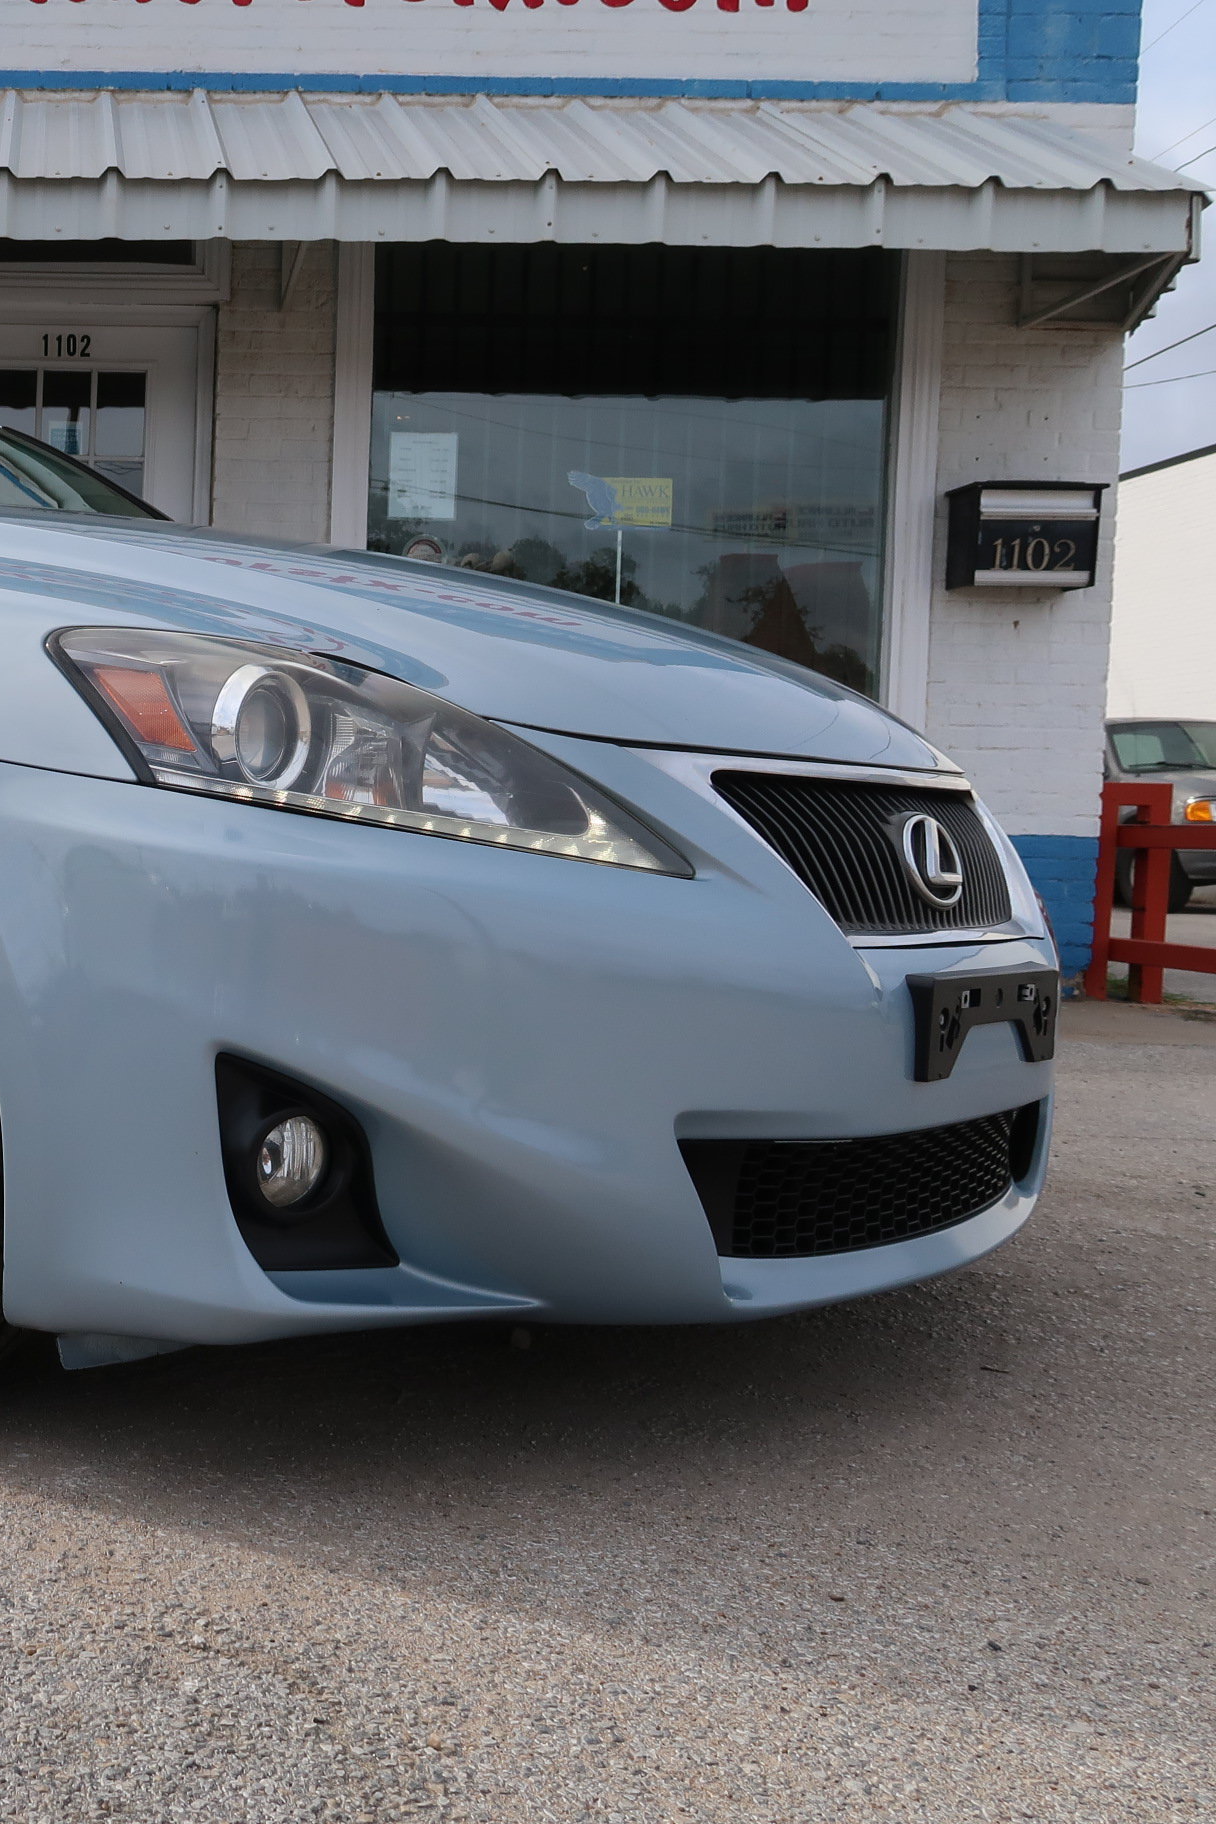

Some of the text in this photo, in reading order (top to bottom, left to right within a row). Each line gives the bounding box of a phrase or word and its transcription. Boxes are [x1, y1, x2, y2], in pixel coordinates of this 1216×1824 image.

[42, 334, 91, 357] 1102
[622, 485, 669, 497] HAWK
[989, 538, 1076, 571] 1102
